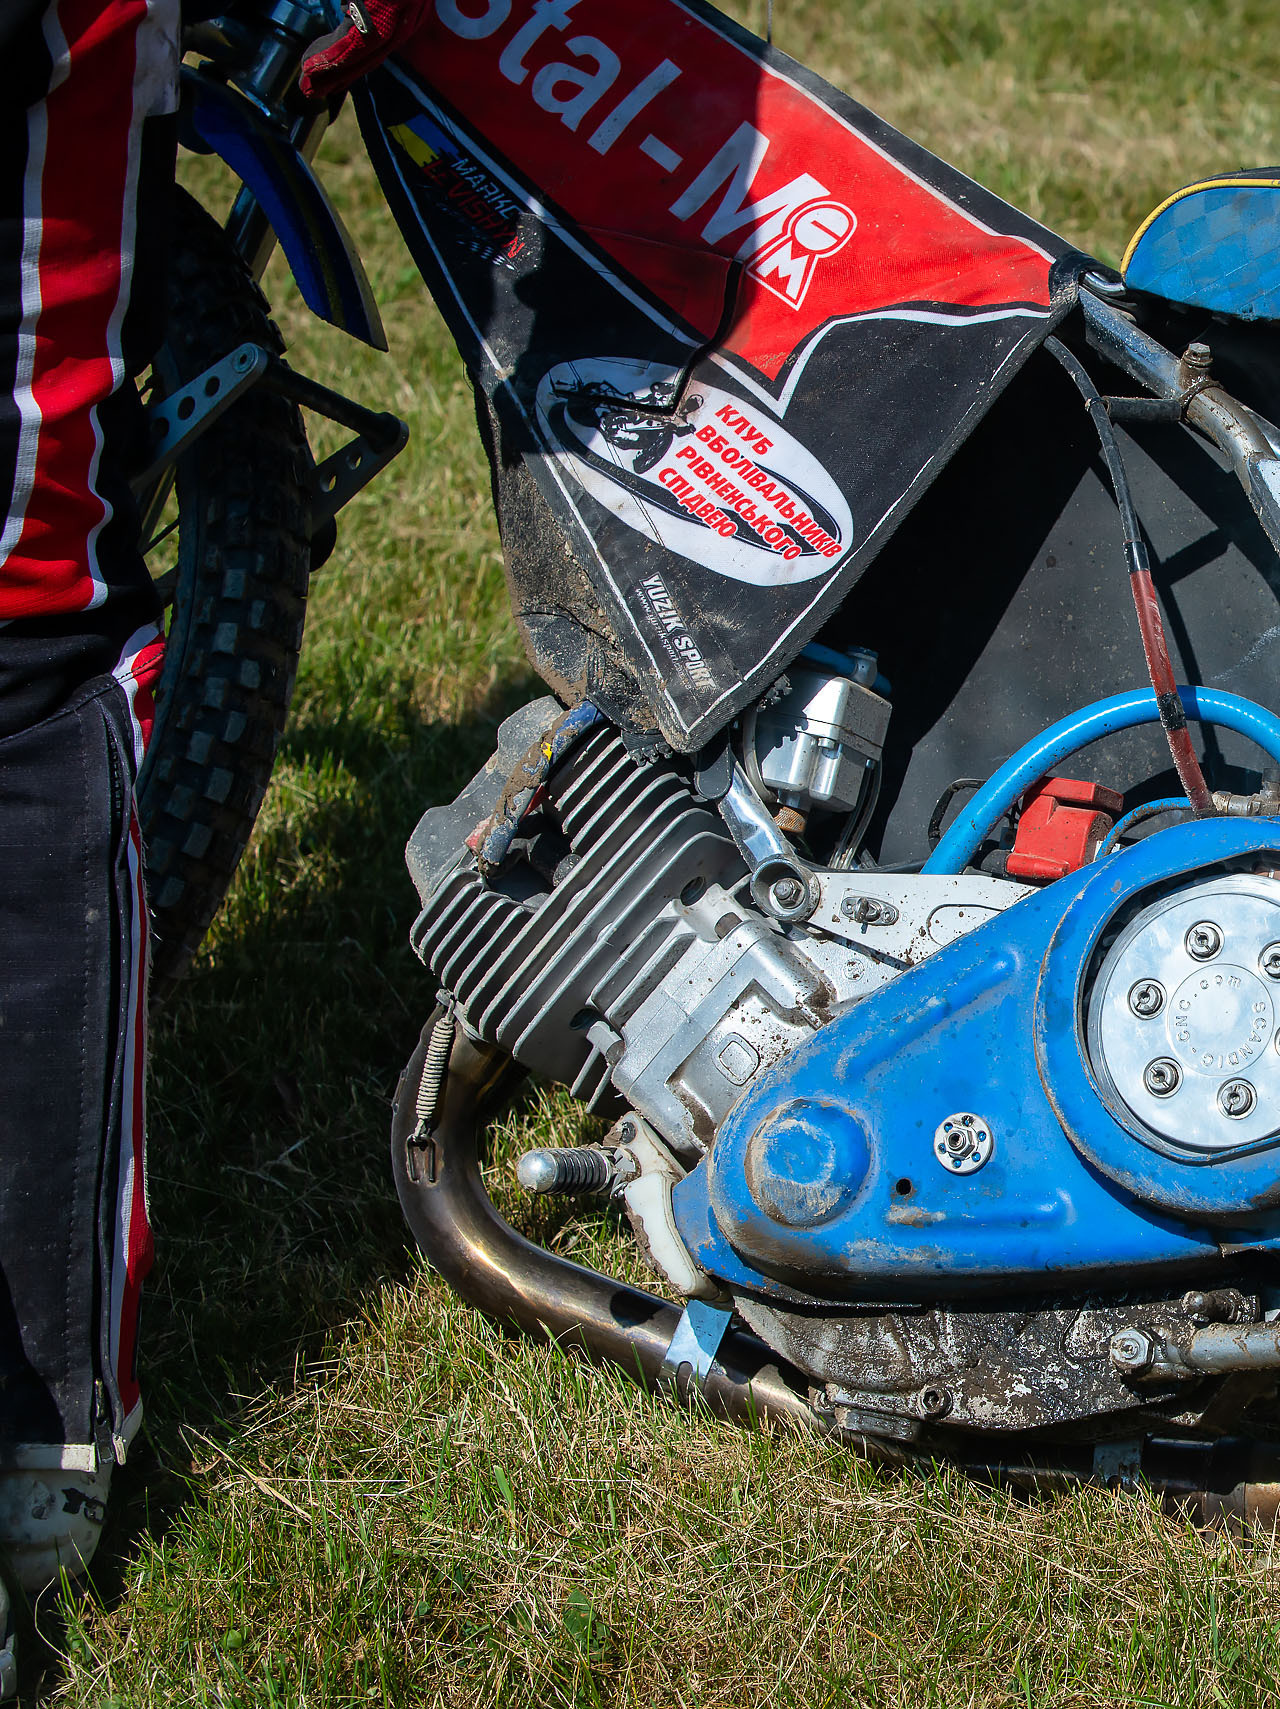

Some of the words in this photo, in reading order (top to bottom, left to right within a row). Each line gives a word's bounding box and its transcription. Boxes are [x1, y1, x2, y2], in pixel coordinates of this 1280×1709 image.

[715, 404, 774, 456] КЛУБ
[658, 467, 738, 538] СПІДВЕЮ
[675, 445, 803, 561] РІВНЕНСЬКОГО
[696, 425, 843, 558] ВБОЛІВАЛЬНИКІВ
[642, 573, 686, 635] YUZIK
[673, 632, 717, 690] SPORT
